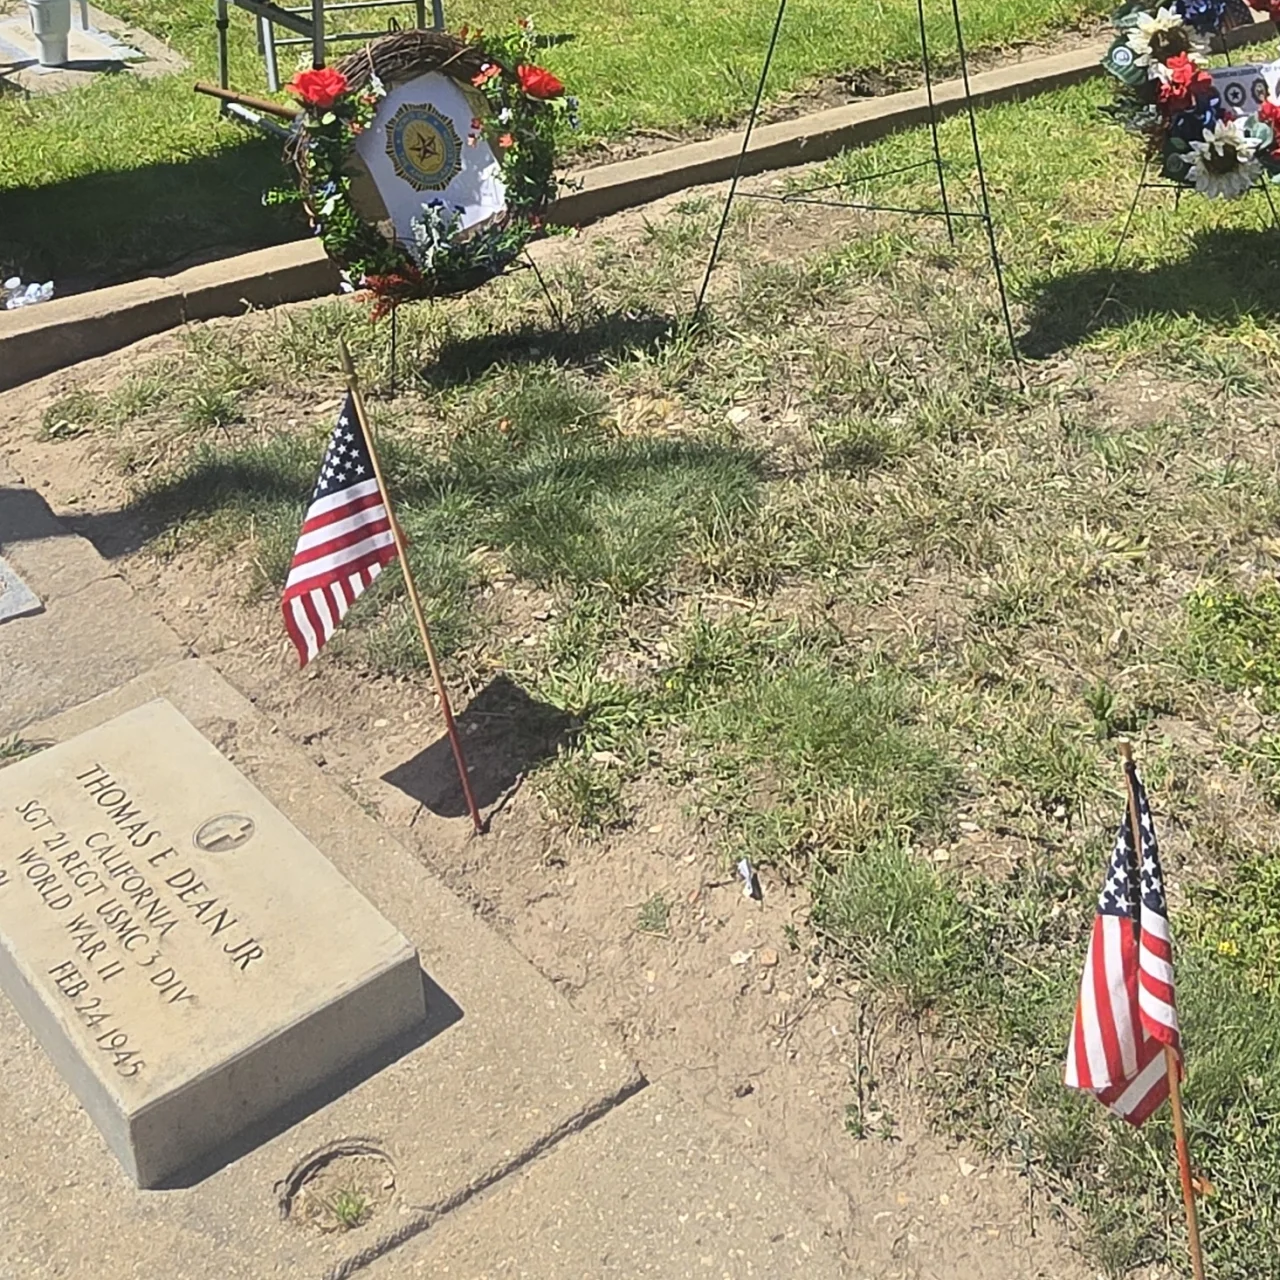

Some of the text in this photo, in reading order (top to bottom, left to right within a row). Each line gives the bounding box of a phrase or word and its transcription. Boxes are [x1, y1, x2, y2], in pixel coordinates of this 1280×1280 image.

[15, 800, 195, 1004] SGT 21 REGT USMC 3 DIV
[16, 846, 125, 981] WORLD WAR II
[76, 763, 264, 971] THOMAS E DEAN JR
[85, 832, 179, 937] CALIFORNIA
[48, 960, 146, 1078] FEB 24 1945
